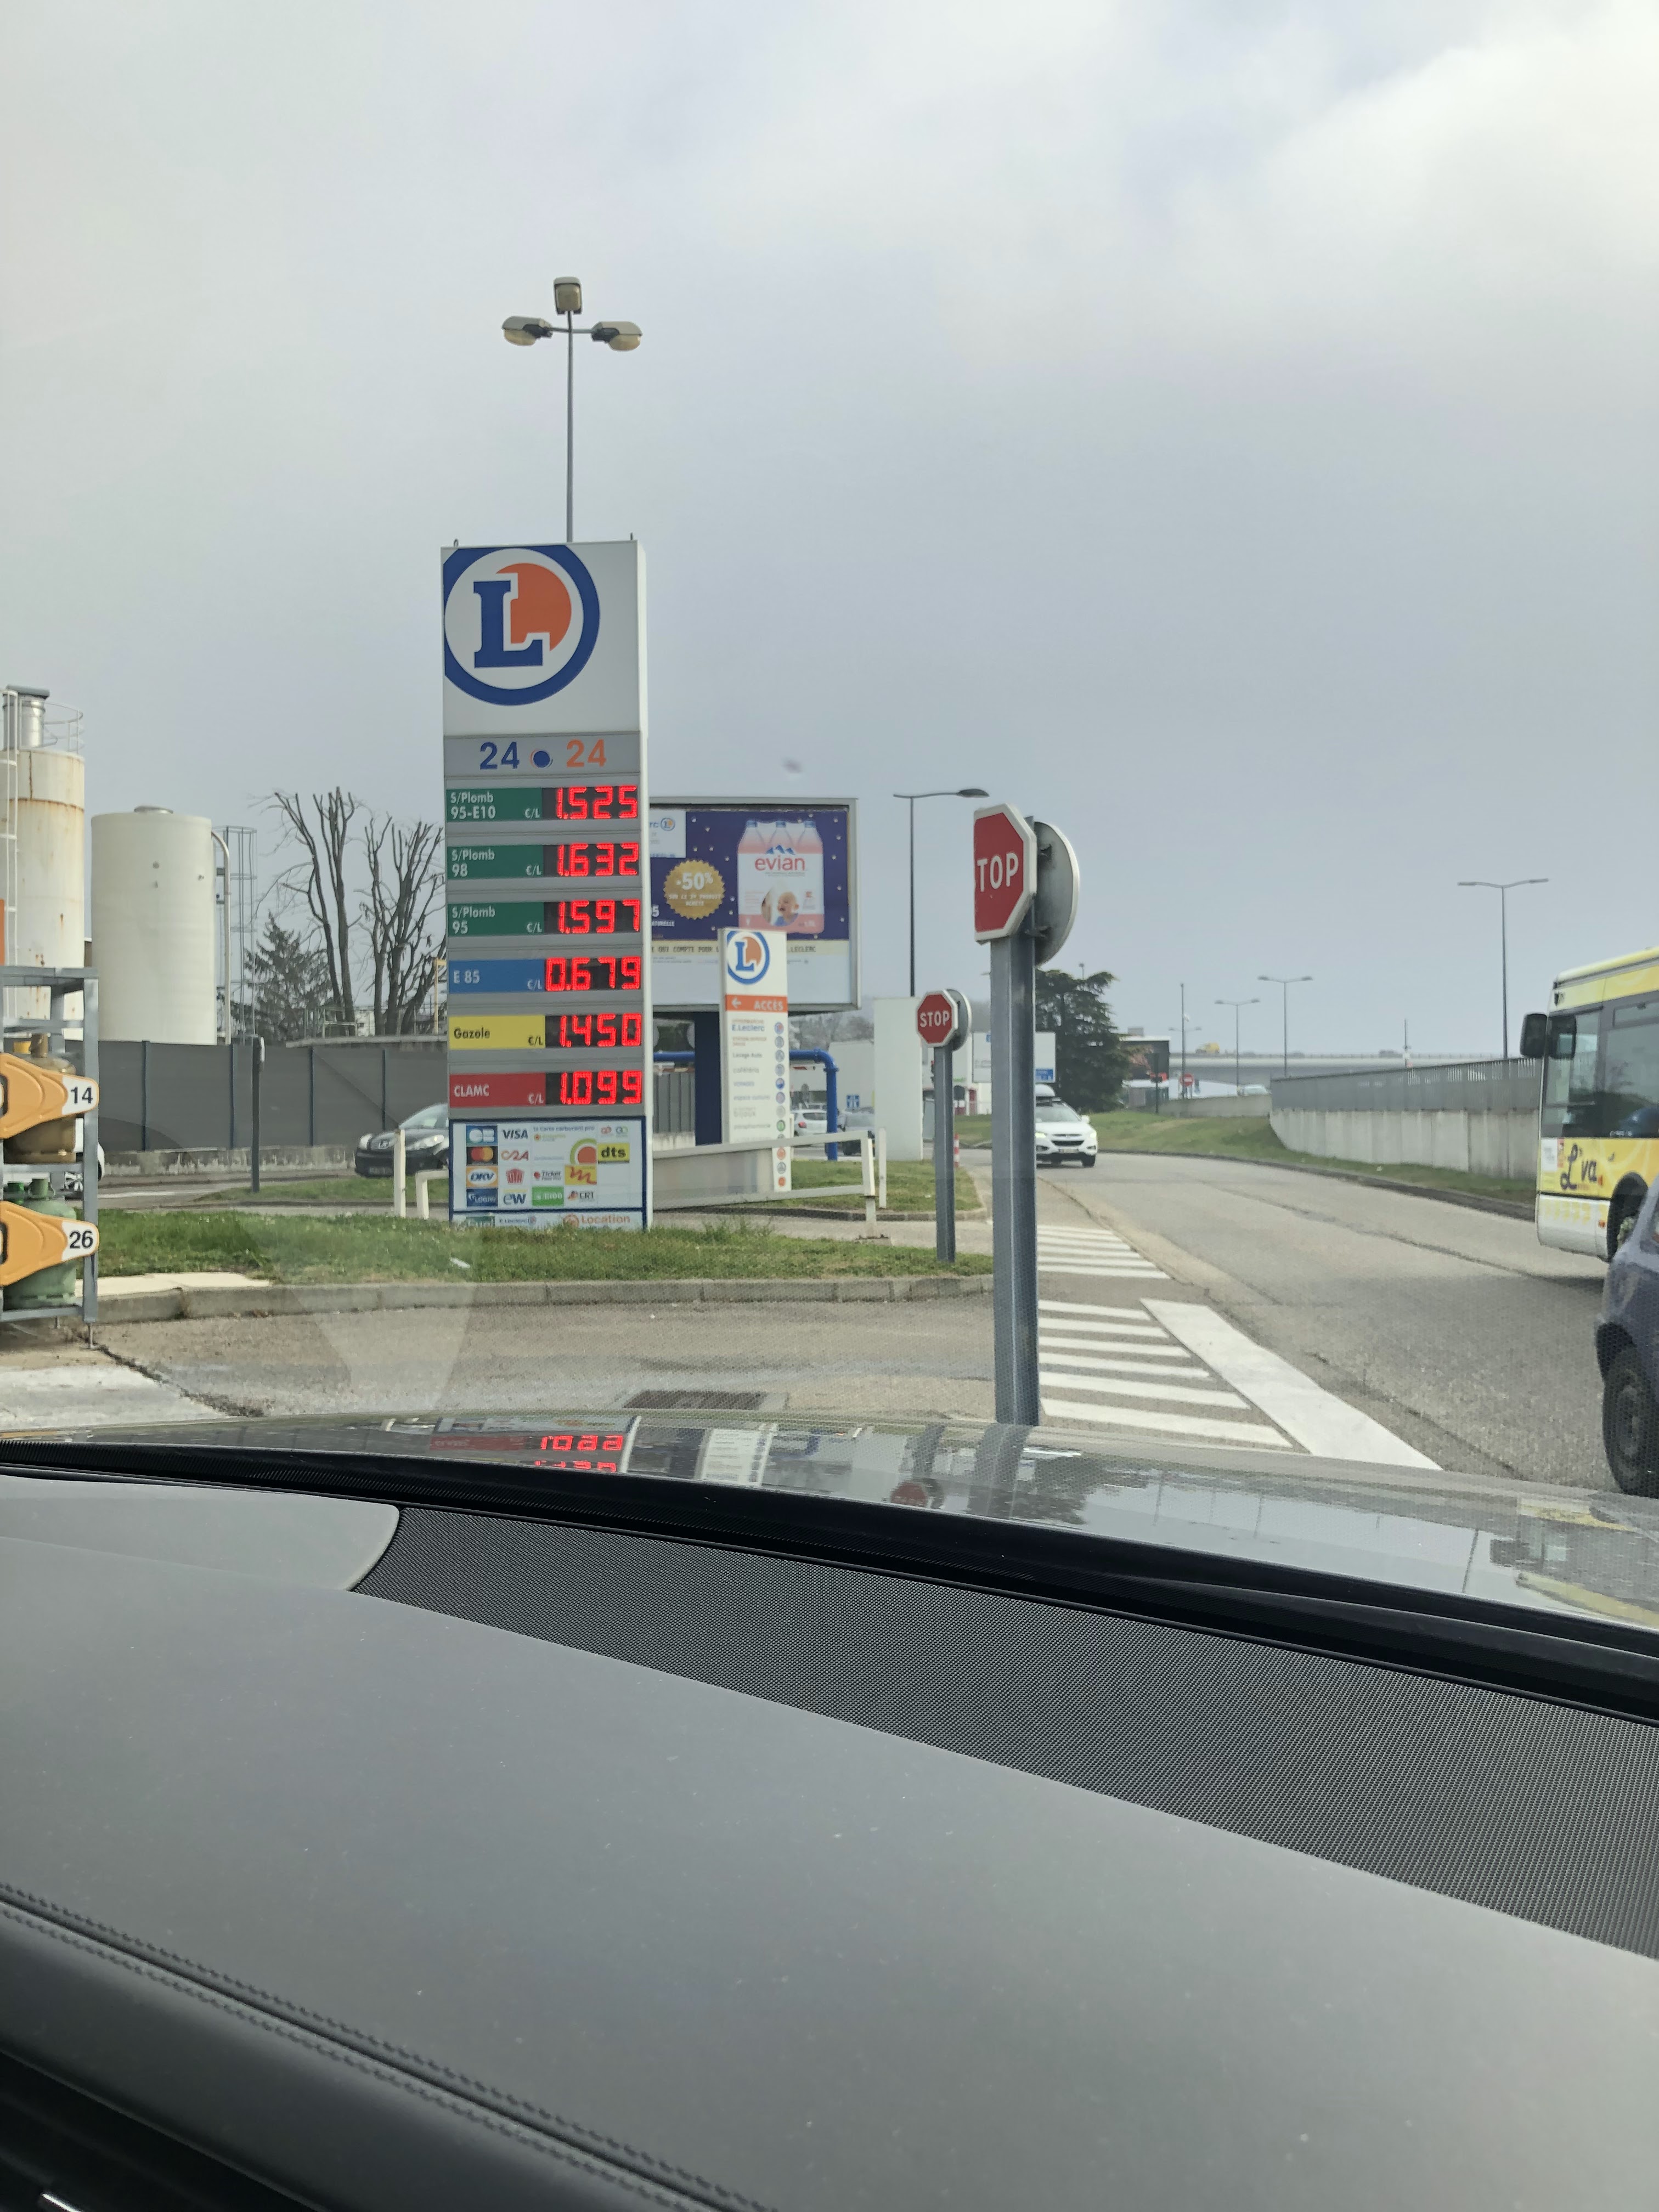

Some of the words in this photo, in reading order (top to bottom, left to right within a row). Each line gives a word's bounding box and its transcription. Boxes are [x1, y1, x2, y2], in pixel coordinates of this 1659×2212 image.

[473, 580, 543, 668] L
[479, 741, 519, 770] 24
[566, 738, 607, 768] 24
[450, 792, 494, 804] S/Plomb
[451, 805, 496, 820] 95-E10
[556, 786, 638, 820] 1.525
[452, 848, 495, 861] S/Plomb
[452, 863, 468, 877] 98
[557, 842, 639, 877] 1.632
[754, 855, 805, 871] evian
[676, 872, 713, 890] -50%
[977, 852, 1019, 892] TOP
[452, 905, 495, 918] S/Plomb
[452, 921, 469, 934] 95
[558, 899, 641, 934] 1.597
[652, 904, 659, 917] 5
[735, 941, 754, 971] L
[453, 970, 461, 984] E
[465, 969, 480, 984] 85
[545, 956, 641, 991] 0.679
[919, 1011, 950, 1028] STOP
[454, 1026, 490, 1039] Gazole
[559, 1013, 642, 1047] 1.450
[70, 1086, 94, 1104] 14
[454, 1085, 489, 1097] CLAMC
[560, 1070, 642, 1105] 1.099
[503, 1128, 528, 1139] VISA
[601, 1146, 626, 1158] dts
[581, 1215, 630, 1224] Location
[69, 1230, 94, 1250] 26
